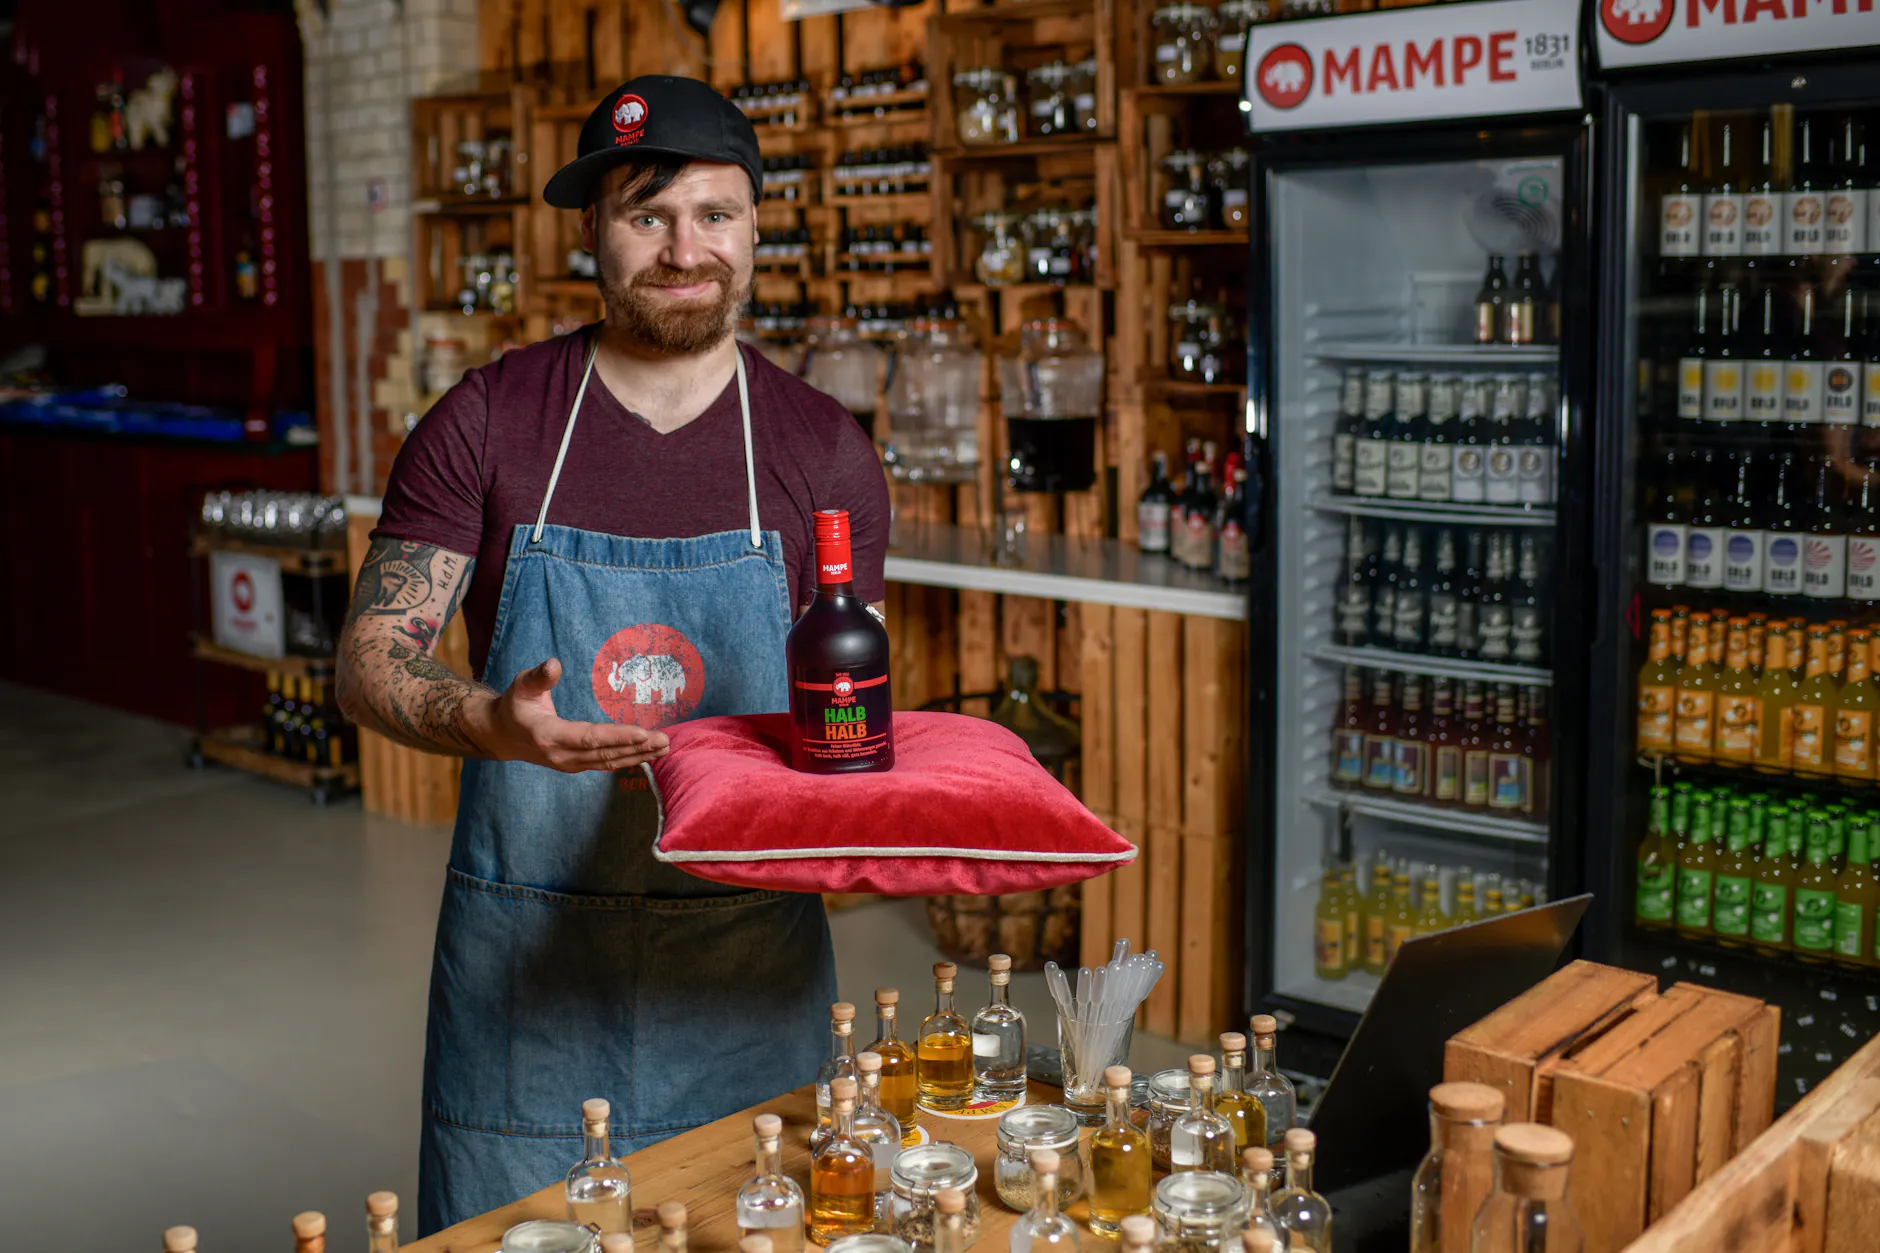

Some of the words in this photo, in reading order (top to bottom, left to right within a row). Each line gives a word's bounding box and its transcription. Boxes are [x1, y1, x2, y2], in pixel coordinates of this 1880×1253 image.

[1524, 33, 1569, 58] 1831
[1322, 30, 1518, 96] MAMPE
[822, 563, 848, 572] MAMPE
[831, 696, 856, 704] MAMPE
[824, 706, 866, 723] HALB
[825, 724, 867, 741] HALB
